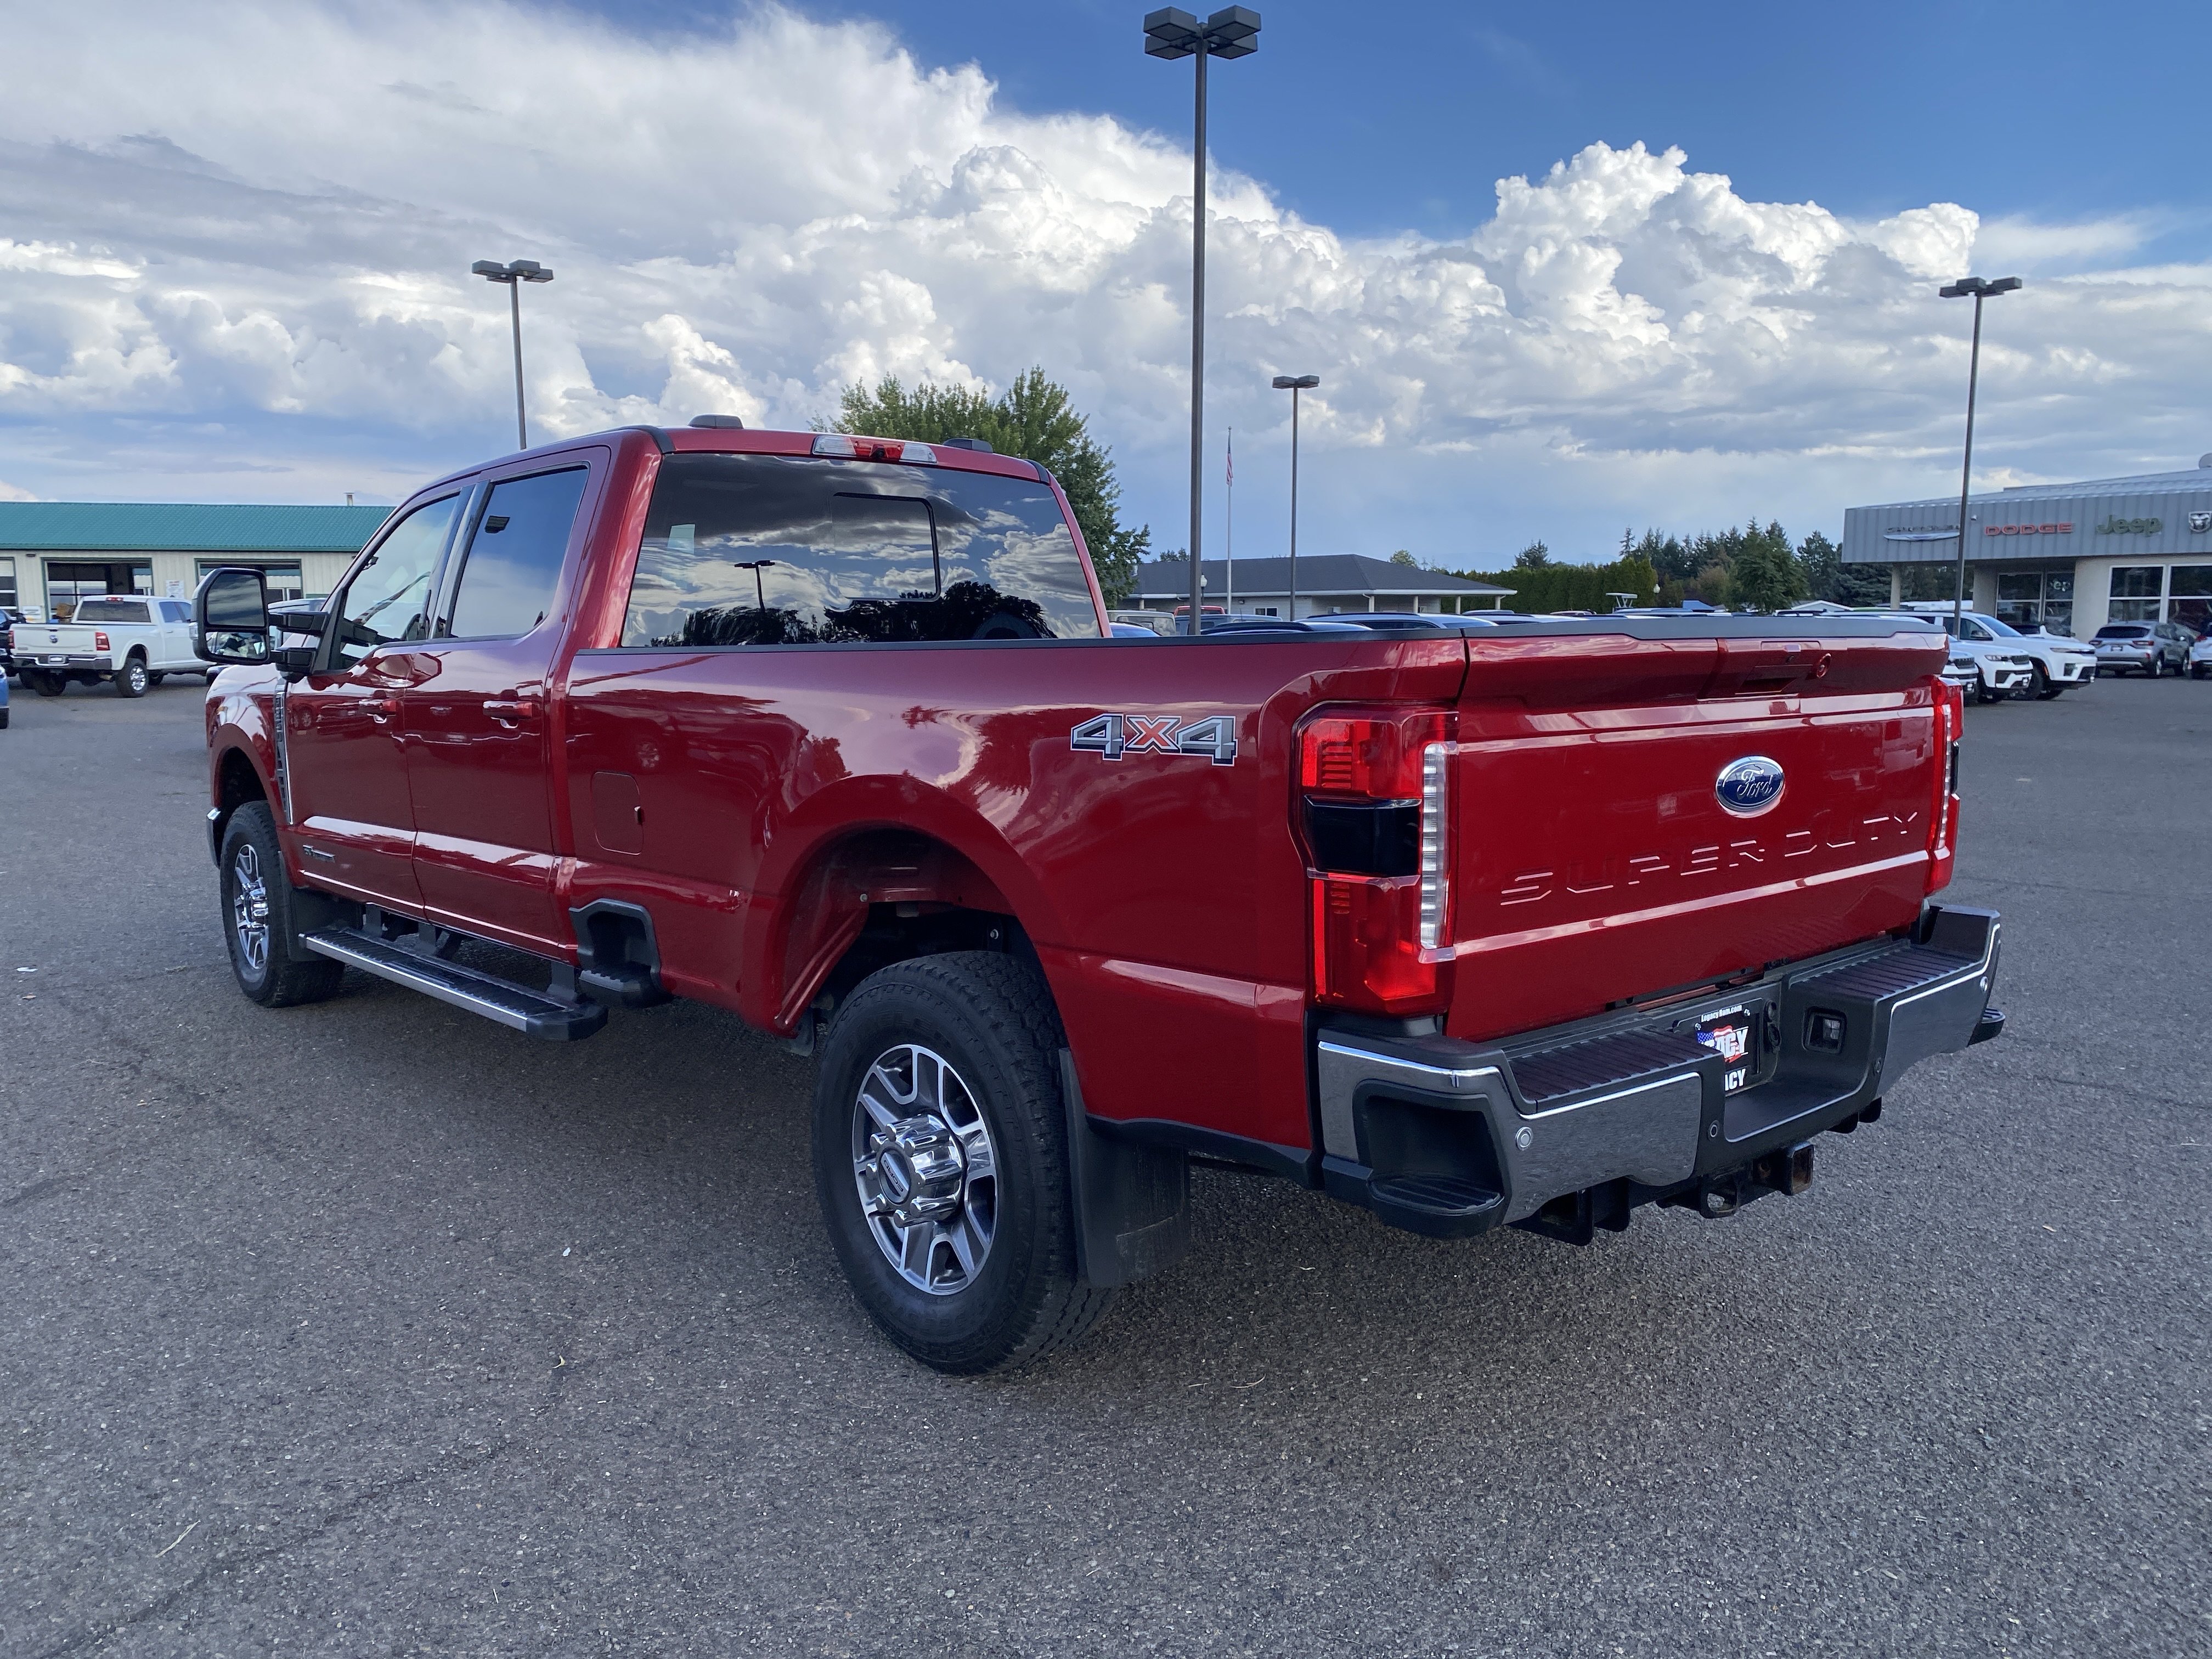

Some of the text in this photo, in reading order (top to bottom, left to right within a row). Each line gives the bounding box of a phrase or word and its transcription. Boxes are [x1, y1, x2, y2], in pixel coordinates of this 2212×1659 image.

[1984, 522, 2073, 536] DODGE
[2095, 515, 2163, 537] Jeep
[1736, 769, 1773, 800] Ford
[1500, 811, 1918, 906] SUPER DUTY
[884, 1160, 904, 1193] FORD
